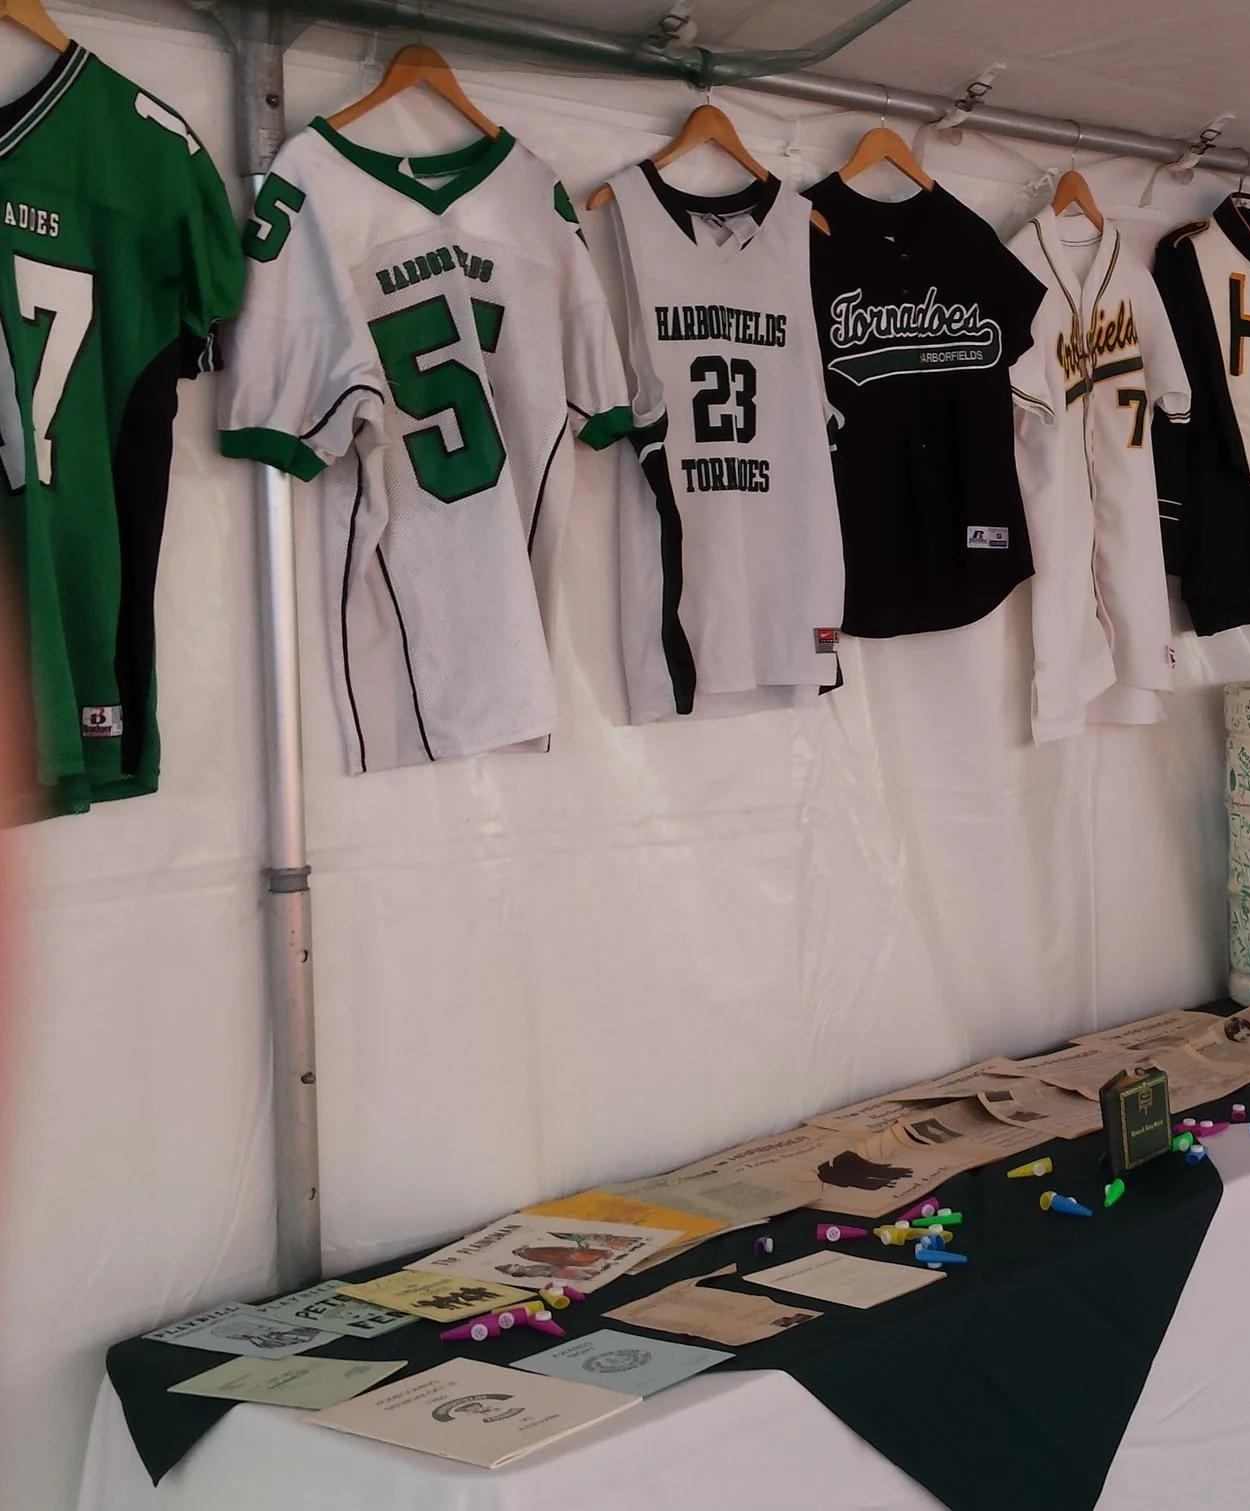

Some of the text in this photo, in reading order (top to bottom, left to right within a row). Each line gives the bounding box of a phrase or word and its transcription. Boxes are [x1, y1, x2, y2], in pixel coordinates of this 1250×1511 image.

[247, 173, 306, 263] 5
[830, 286, 979, 349] Tornadoes
[367, 293, 506, 504] 5
[689, 355, 757, 444] 23
[1115, 387, 1148, 449] 7
[152, 1306, 241, 1339] PLAYBILL
